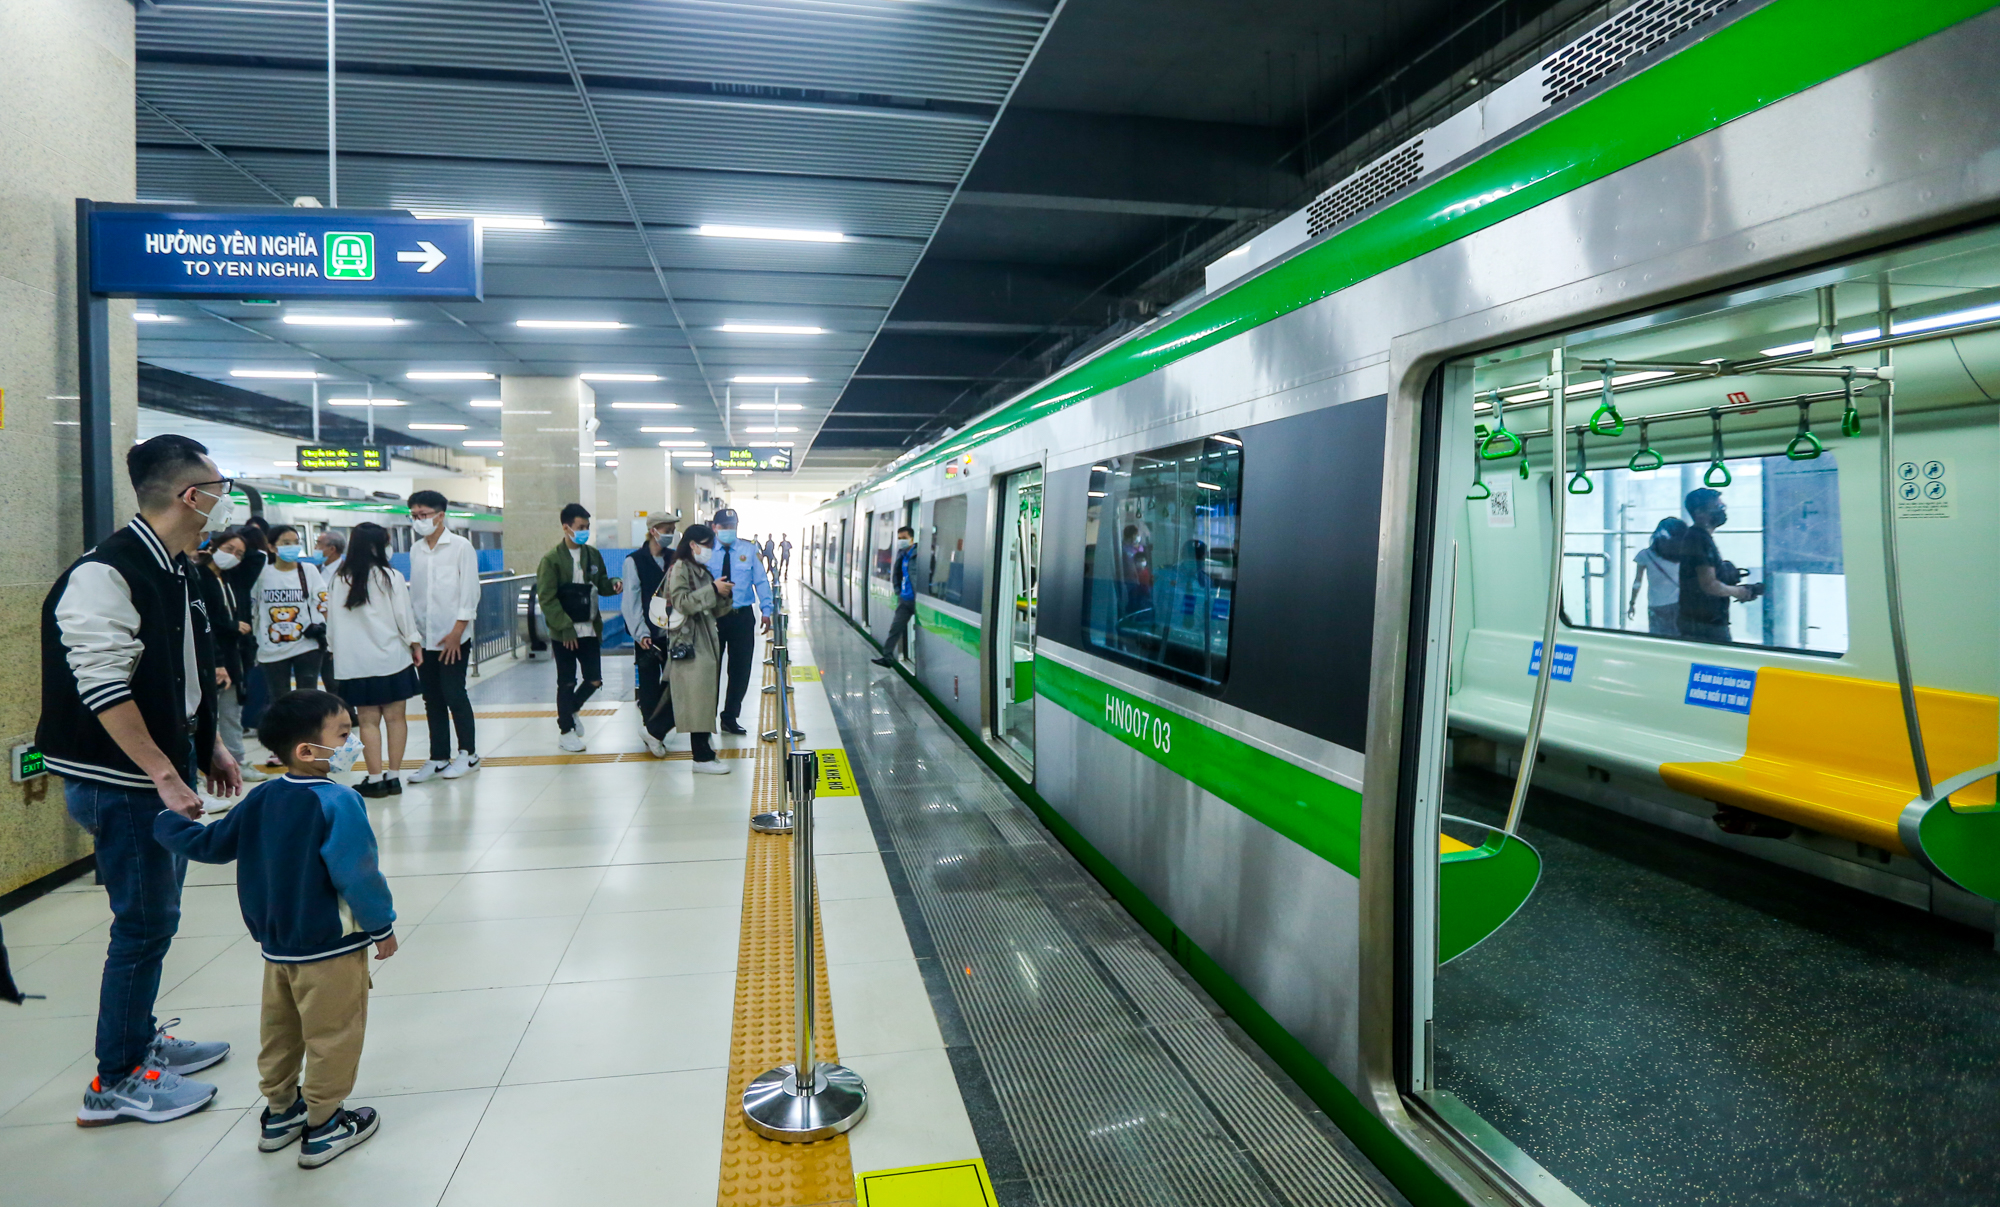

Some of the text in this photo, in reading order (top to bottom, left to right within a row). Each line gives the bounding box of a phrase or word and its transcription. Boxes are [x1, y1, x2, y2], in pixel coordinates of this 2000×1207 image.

[145, 229, 318, 256] HƯỚNG YÊN NGHĨA
[182, 260, 319, 277] TO YEN NGHIA
[1105, 693, 1171, 753] HN007 03
[22, 761, 41, 774] EXIT
